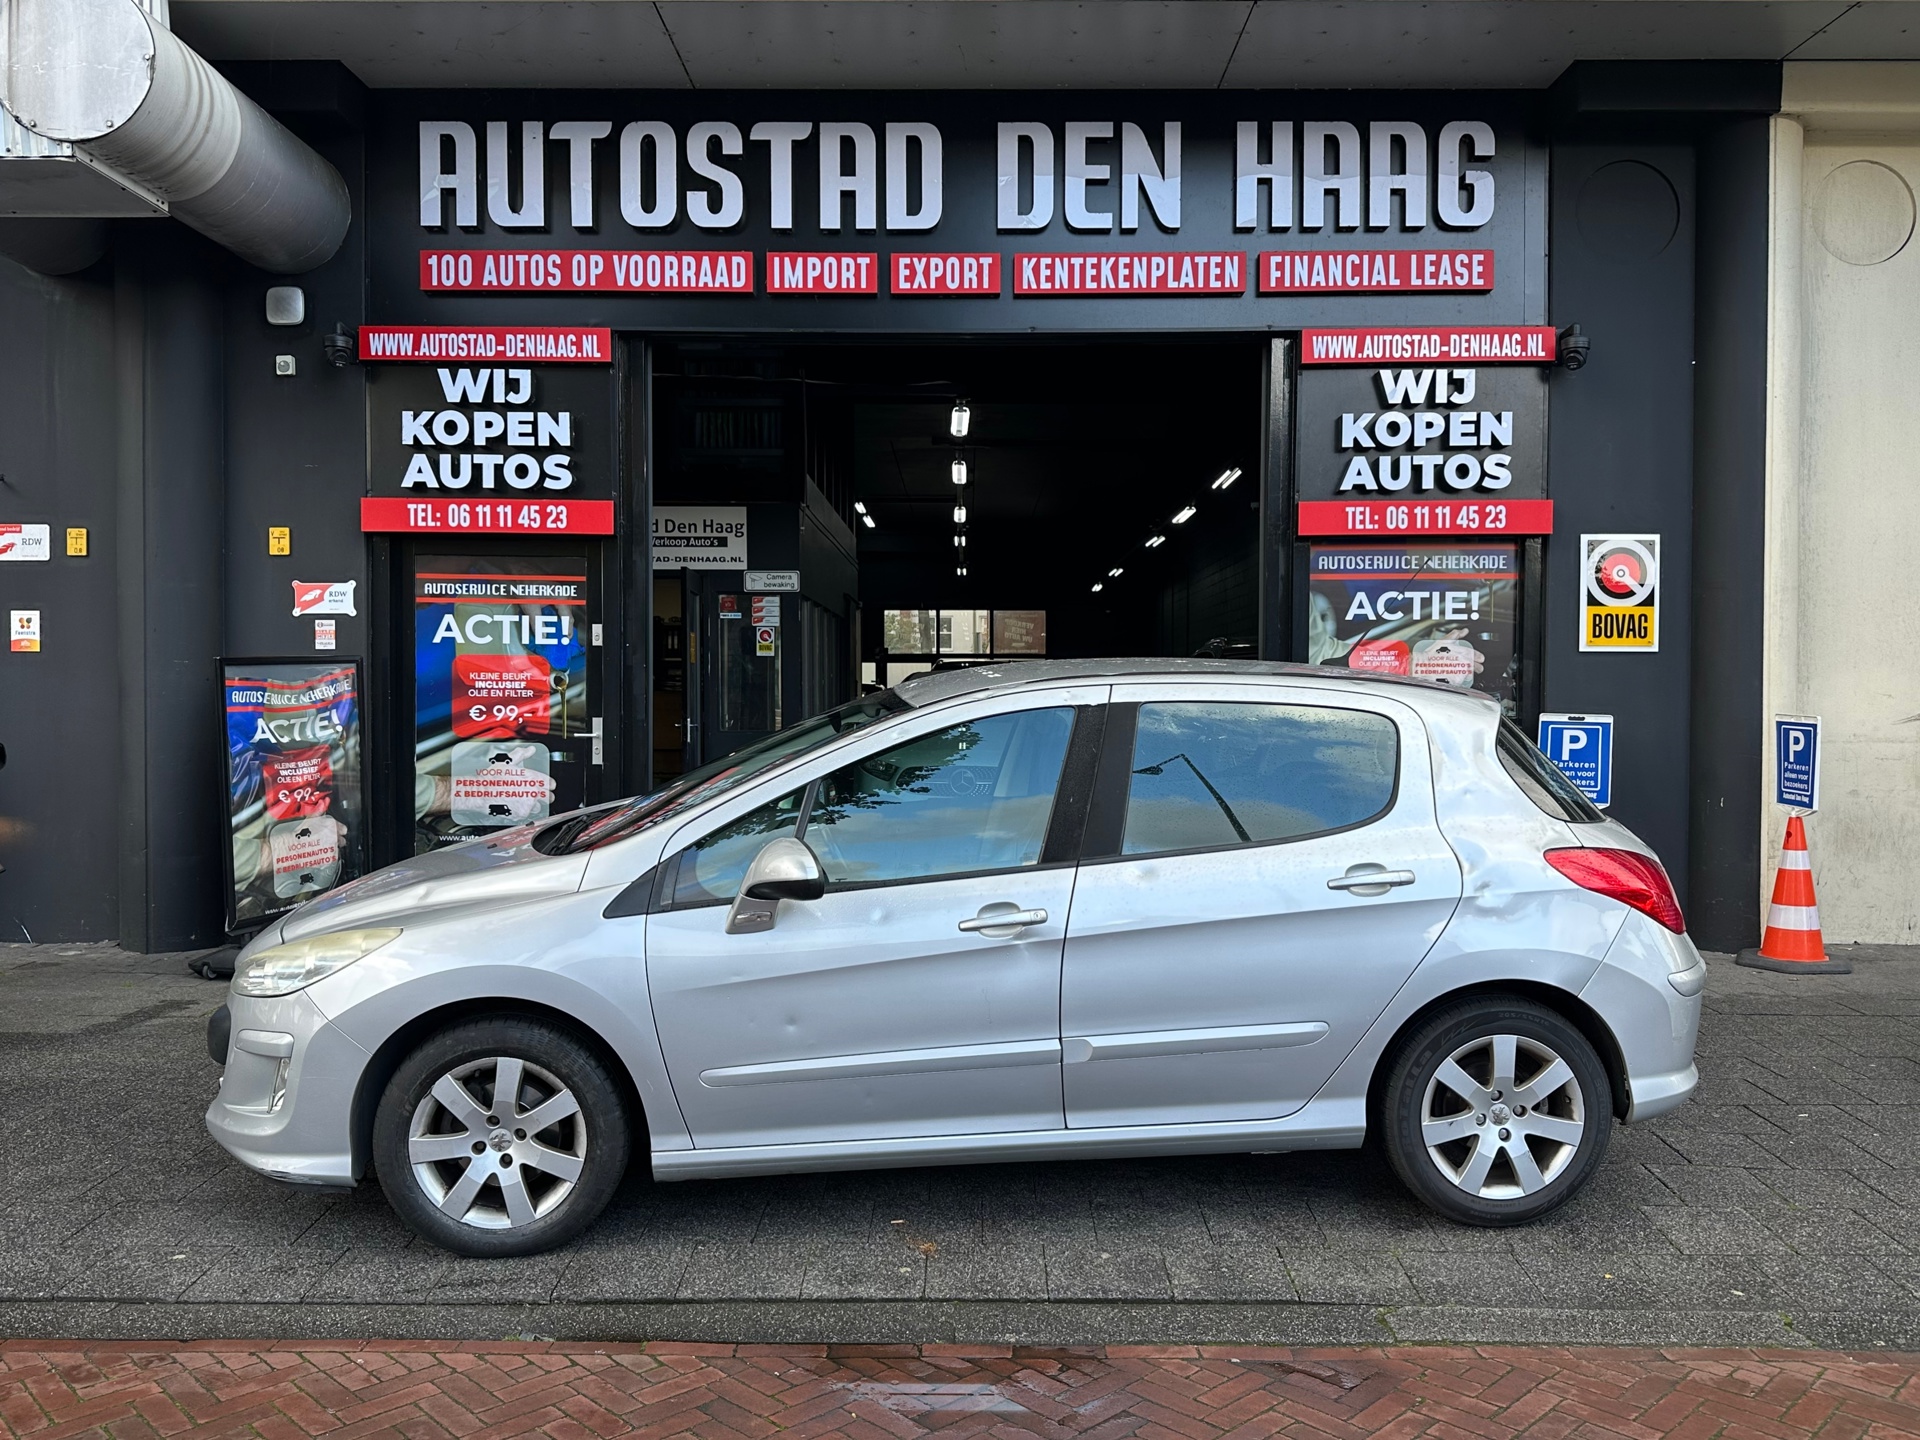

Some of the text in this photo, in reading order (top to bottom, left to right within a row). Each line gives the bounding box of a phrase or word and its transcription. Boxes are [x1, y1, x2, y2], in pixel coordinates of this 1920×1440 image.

[419, 120, 1497, 231] AUTOSTAD DEN HAAG
[427, 254, 748, 288] 100 AUTOS OP VOORRAAD
[773, 256, 871, 290] IMPORT
[899, 256, 992, 290] EXPORT
[1022, 255, 1239, 289] KENTEKENPLATEN
[1269, 254, 1485, 287] FINANCIAL LEASE
[368, 333, 601, 358] WWW.AUTOSTAD-DENHAAG.NL
[1312, 335, 1546, 358] WWW.AUTOSTAD-DENHAAG.NL
[437, 368, 533, 404] WIJ
[1379, 368, 1476, 404] WIJ
[401, 410, 571, 446] KOPEN
[1341, 411, 1513, 447] KOPEN
[400, 453, 573, 490] AUTOS
[1339, 454, 1512, 491] AUTOS
[407, 504, 568, 528] TEL: 06 11 11 45 23
[1346, 506, 1507, 529] TEL: 06 11 11 45 23
[664, 518, 698, 533] Den
[702, 518, 745, 538] Haag
[21, 538, 42, 546] RDW
[689, 537, 719, 546] Auto's
[1318, 555, 1507, 570] AUTOSERVICE NEHERKADE
[763, 581, 795, 589] bewaking
[766, 573, 793, 581] Camera
[424, 582, 578, 597] AUTOSERVICE NEHERKADE
[1345, 591, 1480, 621] ACTIE!
[432, 613, 571, 646] ACTIE!
[1592, 613, 1648, 639] BOVAG
[469, 672, 532, 680] KLEINE BEURT
[475, 681, 527, 689] INCLUSIEF
[468, 689, 489, 697] OLIE
[505, 690, 534, 698] FILTER
[469, 704, 533, 724] € 99,-
[249, 708, 343, 744] ACTIE!
[1562, 729, 1588, 760] P
[1789, 730, 1805, 762] P
[274, 758, 322, 770] KLEINE BEURT
[279, 766, 319, 776] INCLUSIEF
[475, 769, 526, 777] VOOR ALLE
[1784, 761, 1809, 771] Parkeren
[292, 775, 302, 783] EN
[455, 779, 545, 787] PERSONENAUTO'S
[1784, 771, 1809, 781] alleen voor
[1784, 779, 1808, 790] bezoekers
[278, 789, 291, 803] €
[454, 790, 547, 798] & BEDRIJFSAUTO'S
[276, 846, 335, 864] PERSONENAUTO'S
[288, 840, 321, 852] VOOR ALLE
[282, 856, 337, 873] BEDRIJFSAUTO'S
